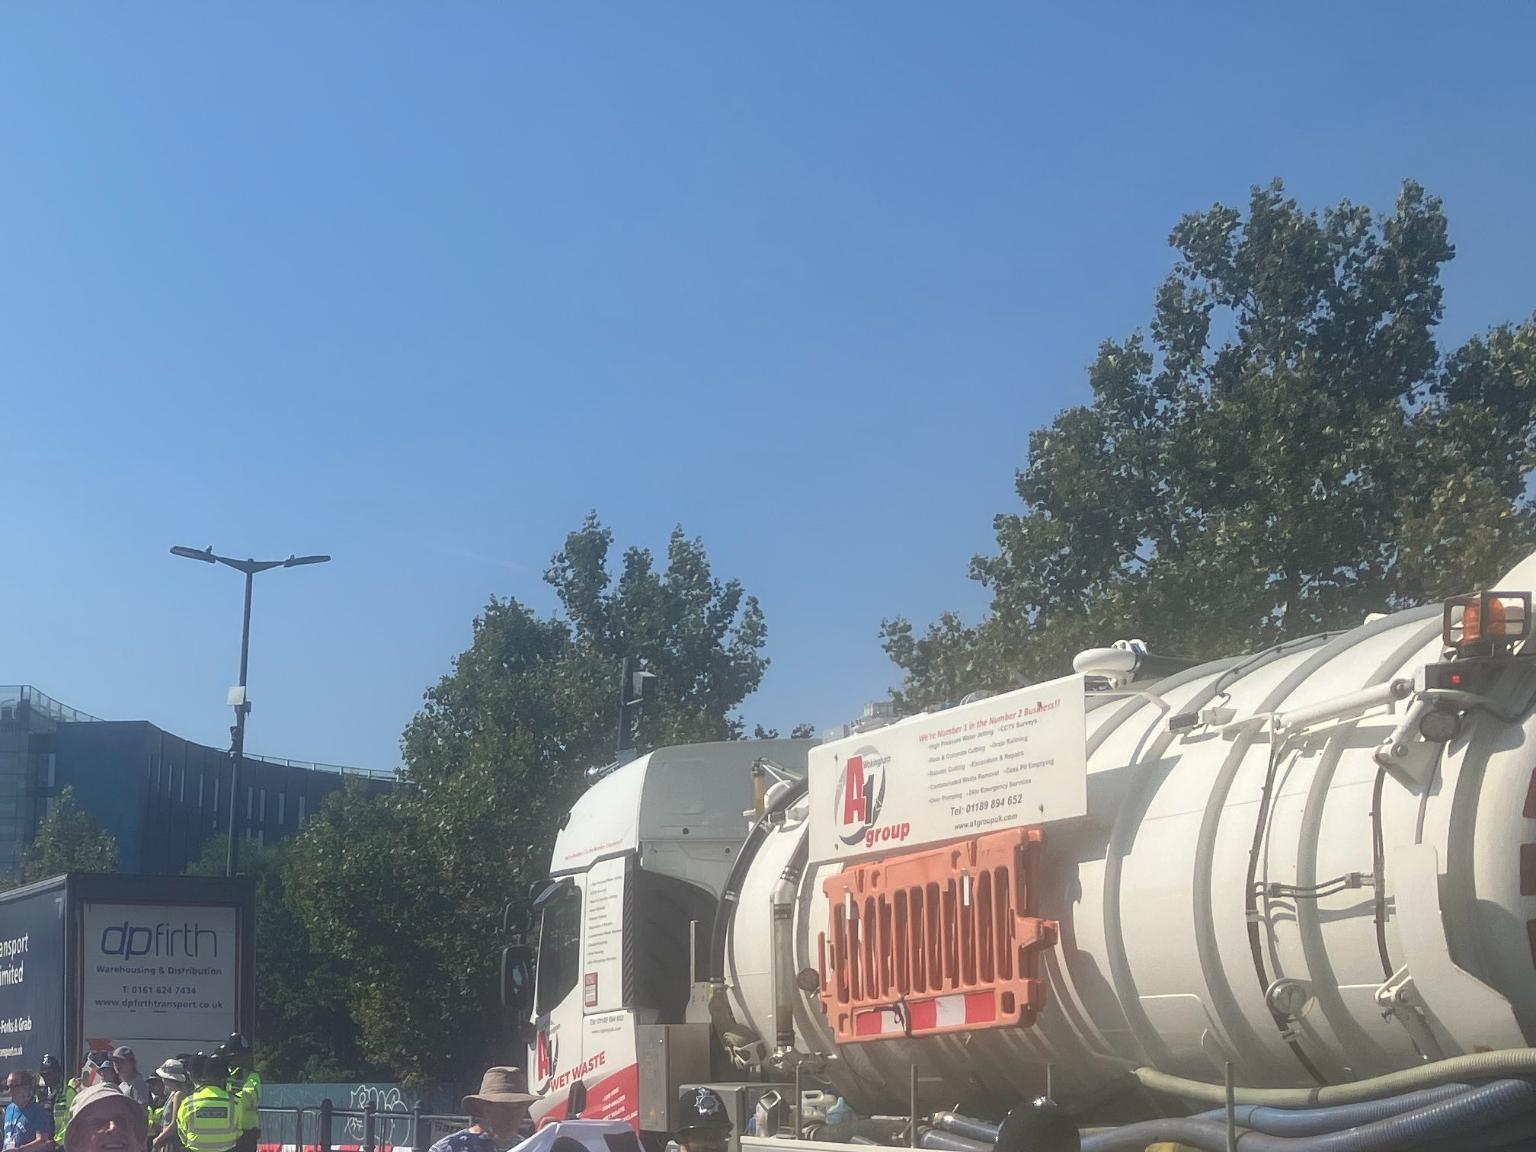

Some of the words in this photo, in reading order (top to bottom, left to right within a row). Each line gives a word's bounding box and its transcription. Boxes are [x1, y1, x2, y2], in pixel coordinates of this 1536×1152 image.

[937, 726, 962, 739] Number
[977, 719, 987, 729] the
[989, 712, 1017, 725] Number
[1018, 709, 1023, 718] 2
[844, 755, 874, 825] A1
[966, 800, 989, 814] 01189
[990, 797, 1005, 809] 894
[1007, 793, 1023, 806] 652
[866, 822, 910, 848] group
[101, 921, 218, 961] dpfirth
[96, 964, 156, 976] Warehousing
[158, 966, 165, 975] &
[168, 966, 223, 976] Distribution
[131, 985, 153, 994] 0161
[156, 985, 173, 994] 624
[95, 998, 223, 1009] www.dpfirthtransport.co.uk
[550, 1069, 571, 1093] WET
[572, 1050, 606, 1082] WASTE
